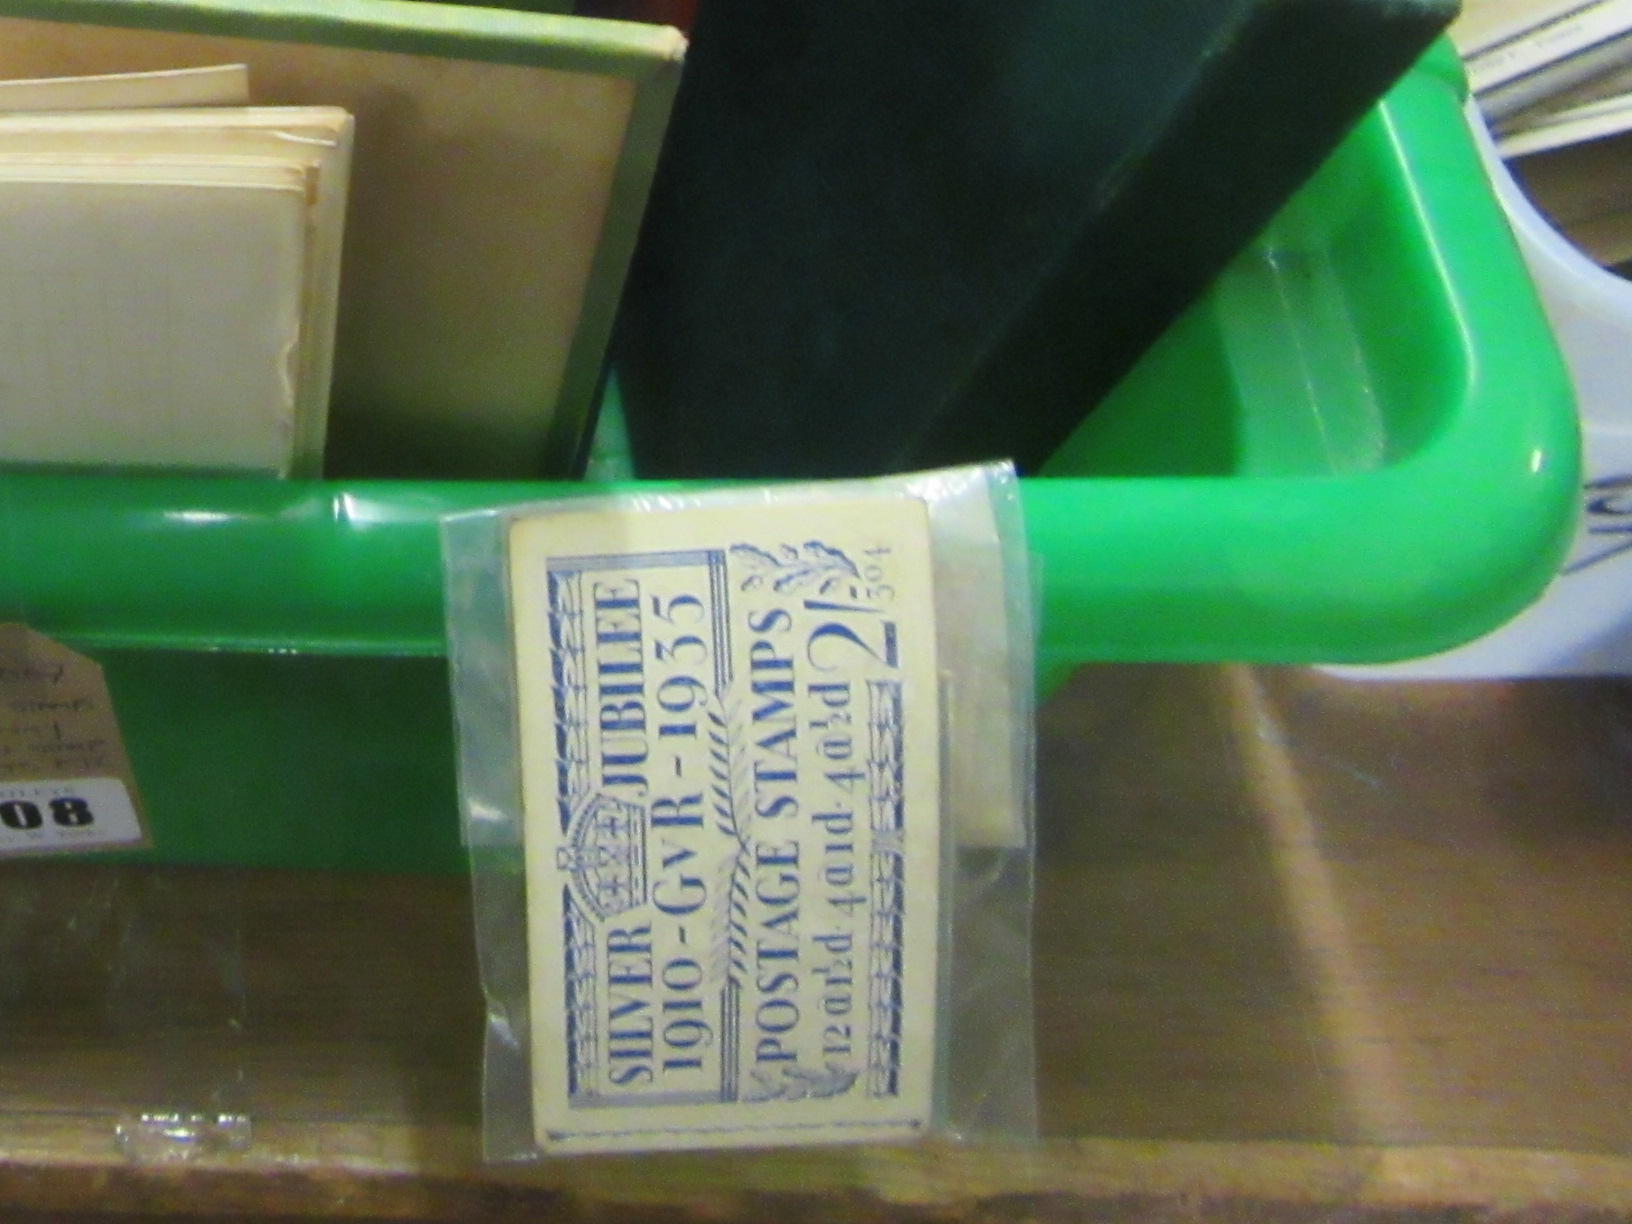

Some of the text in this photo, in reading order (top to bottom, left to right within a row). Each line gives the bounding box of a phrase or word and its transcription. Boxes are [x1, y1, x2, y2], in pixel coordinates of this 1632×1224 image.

[650, 594, 709, 740] 1935
[592, 578, 655, 1086] SILVER JUBILEE
[747, 606, 802, 1064] POSTAGE STAMPS
[661, 956, 714, 1074] 1910
